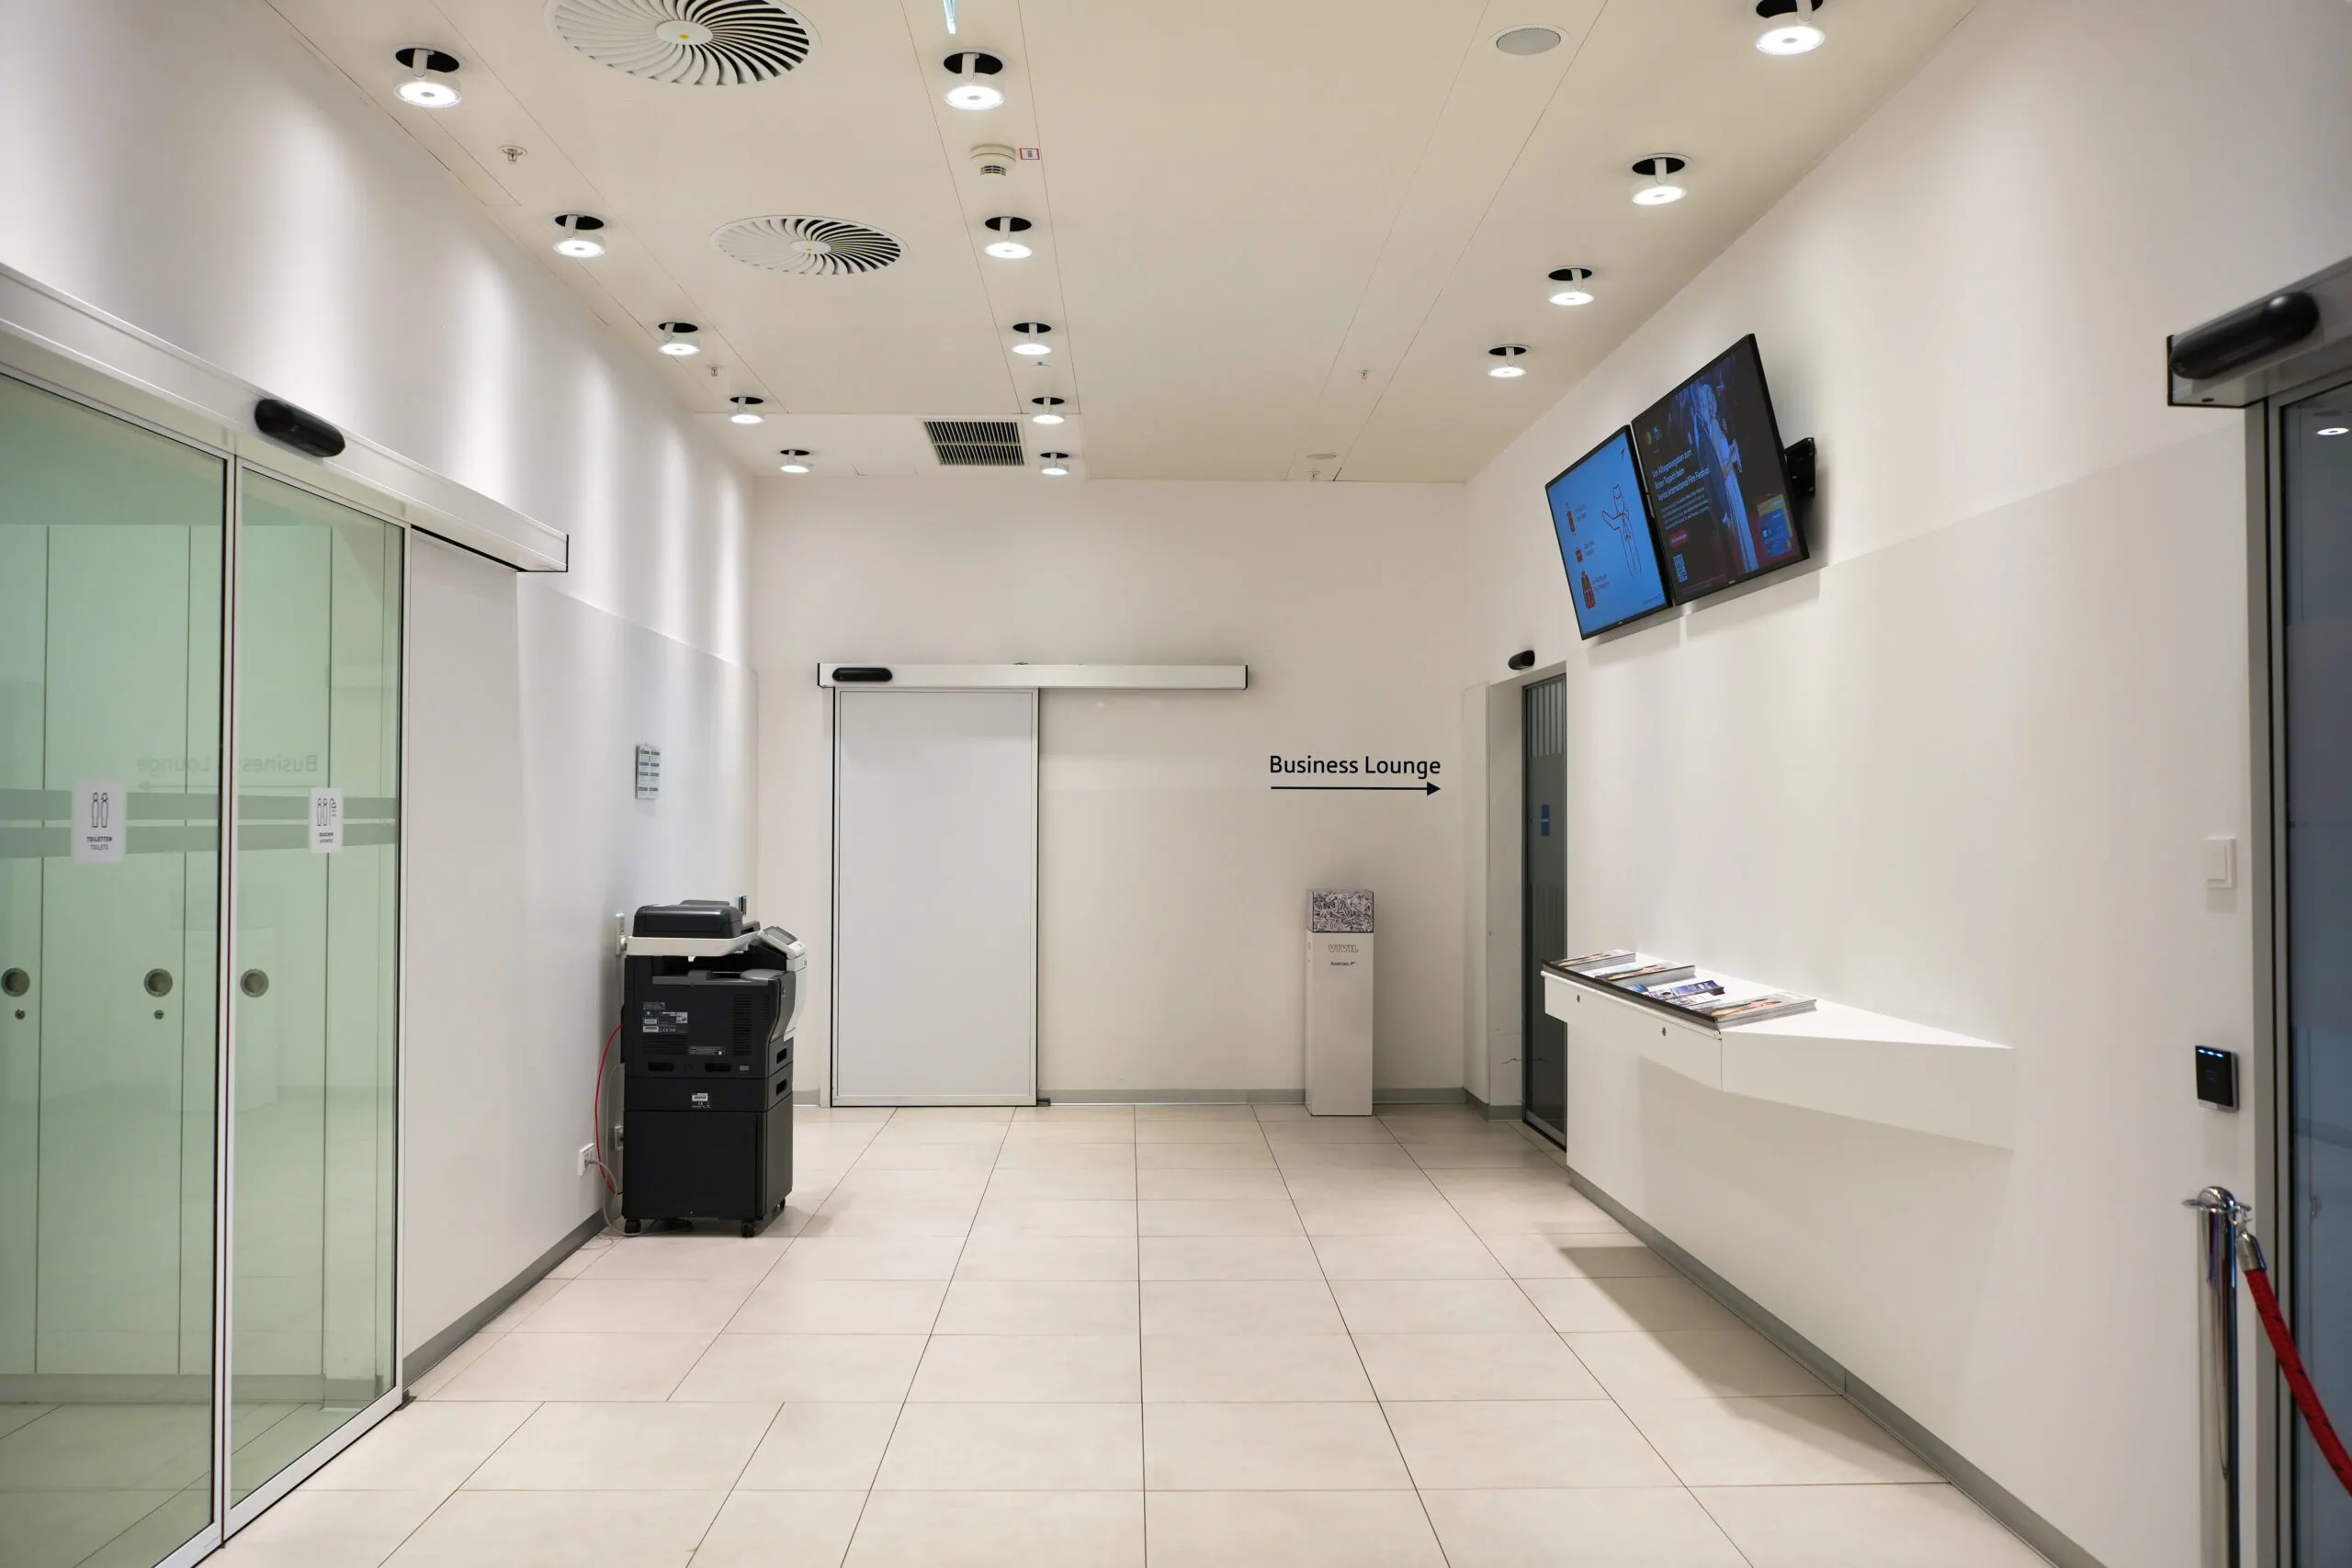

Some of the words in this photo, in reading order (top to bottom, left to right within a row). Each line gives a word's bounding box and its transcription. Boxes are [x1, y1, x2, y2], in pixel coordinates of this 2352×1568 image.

[1270, 755, 1359, 773] Business
[1365, 756, 1441, 779] Lounge
[1328, 943, 1359, 953] VIVIL
